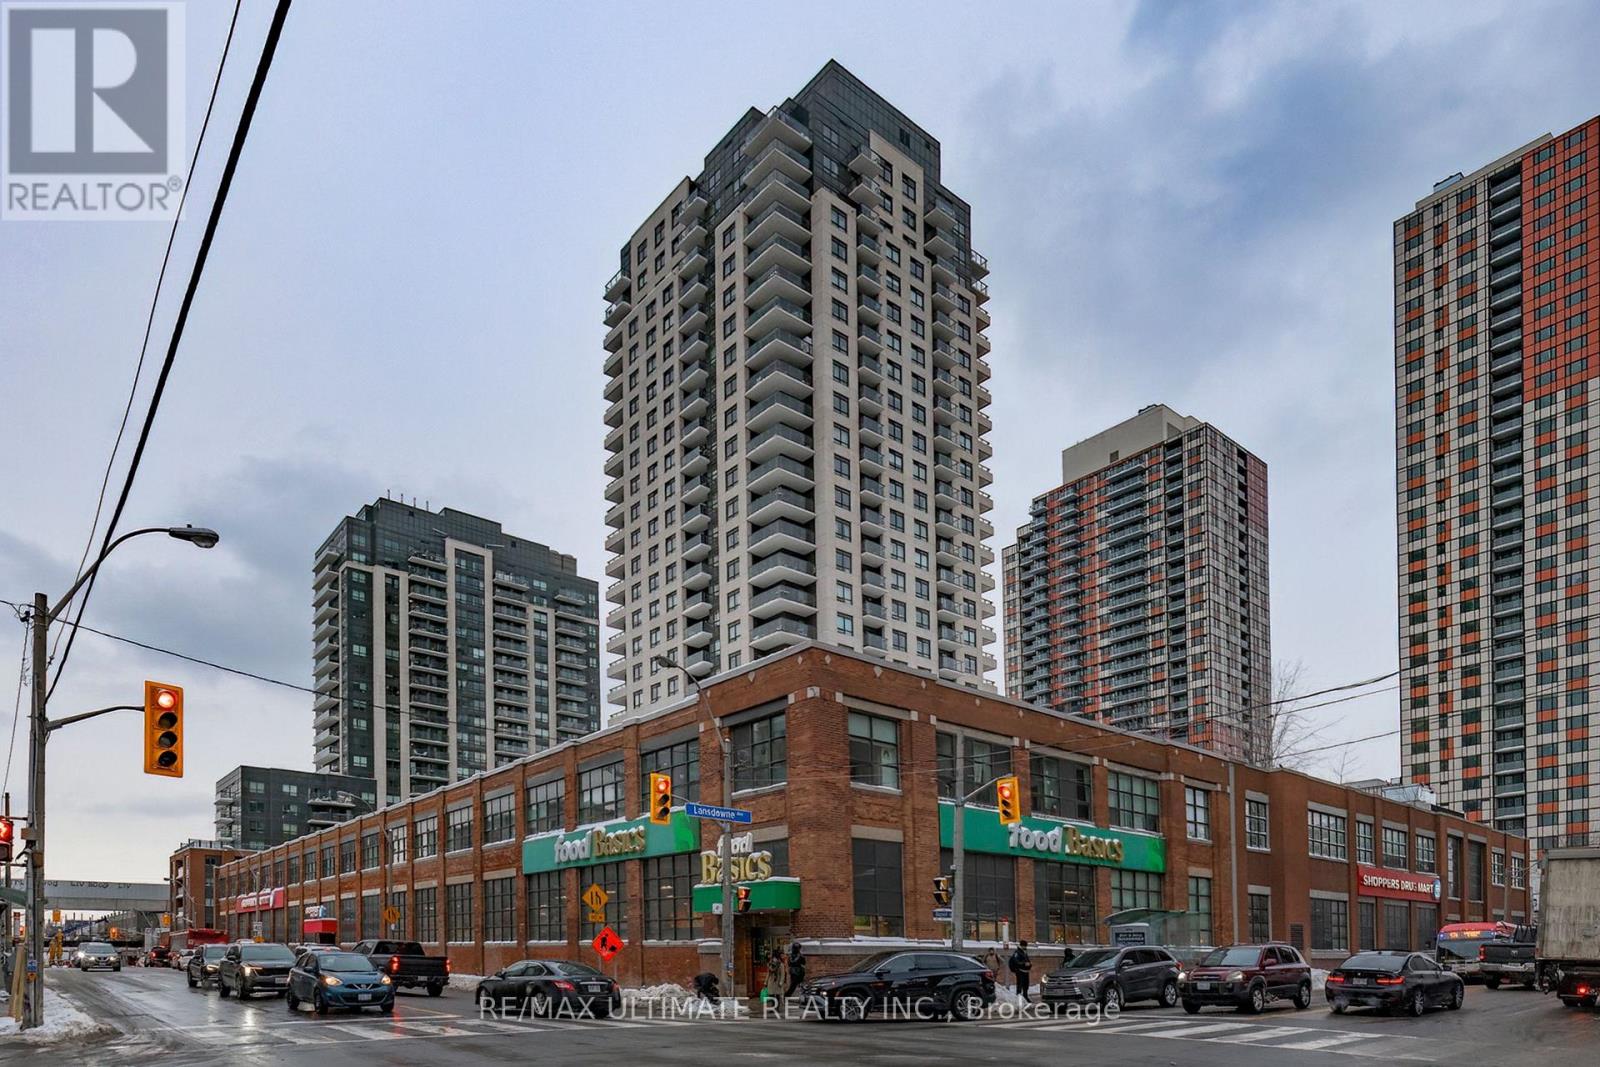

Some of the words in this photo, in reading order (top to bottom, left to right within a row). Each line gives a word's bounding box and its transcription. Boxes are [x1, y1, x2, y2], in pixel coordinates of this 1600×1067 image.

[693, 804, 735, 819] Lansdowne
[554, 830, 592, 864] food
[717, 832, 754, 855] fod
[1007, 823, 1063, 853] food
[1363, 874, 1400, 890] SHOPPERS
[1417, 882, 1434, 894] MART
